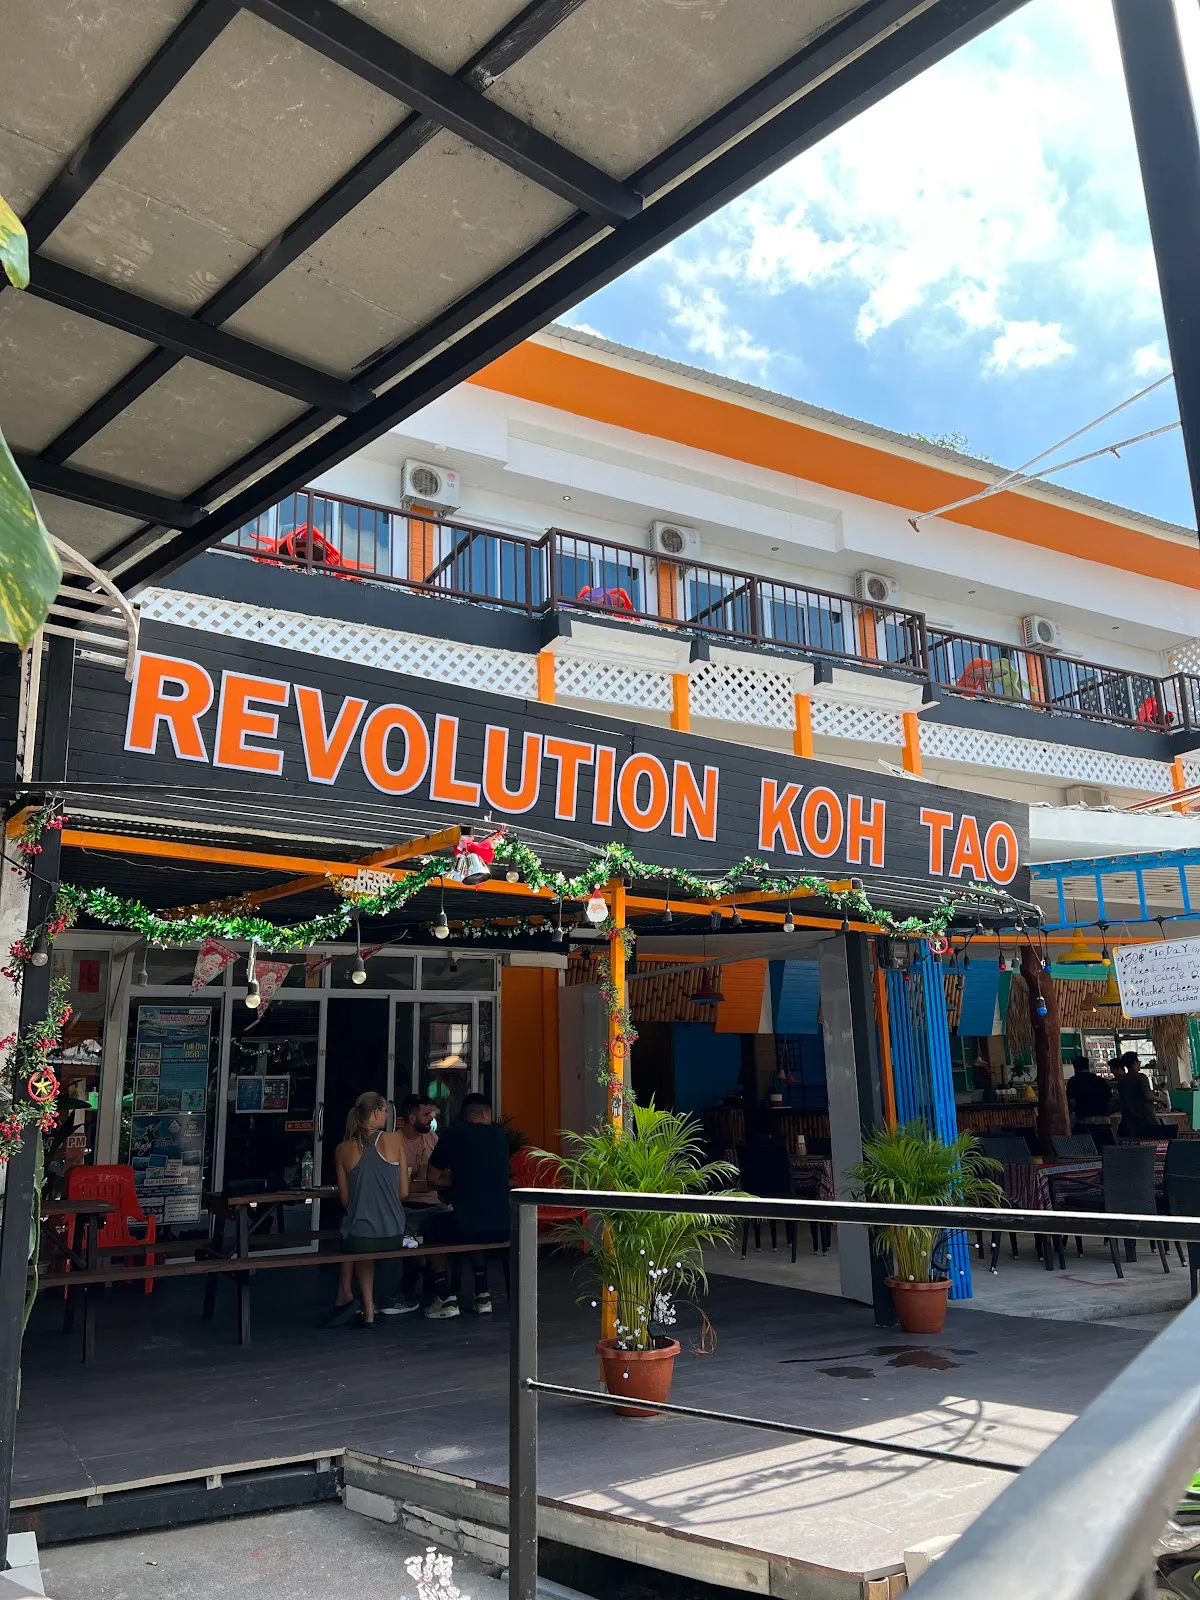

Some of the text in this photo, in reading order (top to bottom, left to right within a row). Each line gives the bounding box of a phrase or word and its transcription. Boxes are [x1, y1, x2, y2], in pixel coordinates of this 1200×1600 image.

[123, 650, 1019, 886] REVOLUTION KOH TAO
[357, 868, 396, 886] MERRY
[1161, 962, 1182, 973] Seed
[1130, 976, 1149, 986] Keep
[1169, 982, 1199, 994] Cheesy
[1131, 993, 1198, 1010] Mexican Chicken
[183, 1042, 208, 1051] Full Day
[67, 1136, 87, 1148] PM
